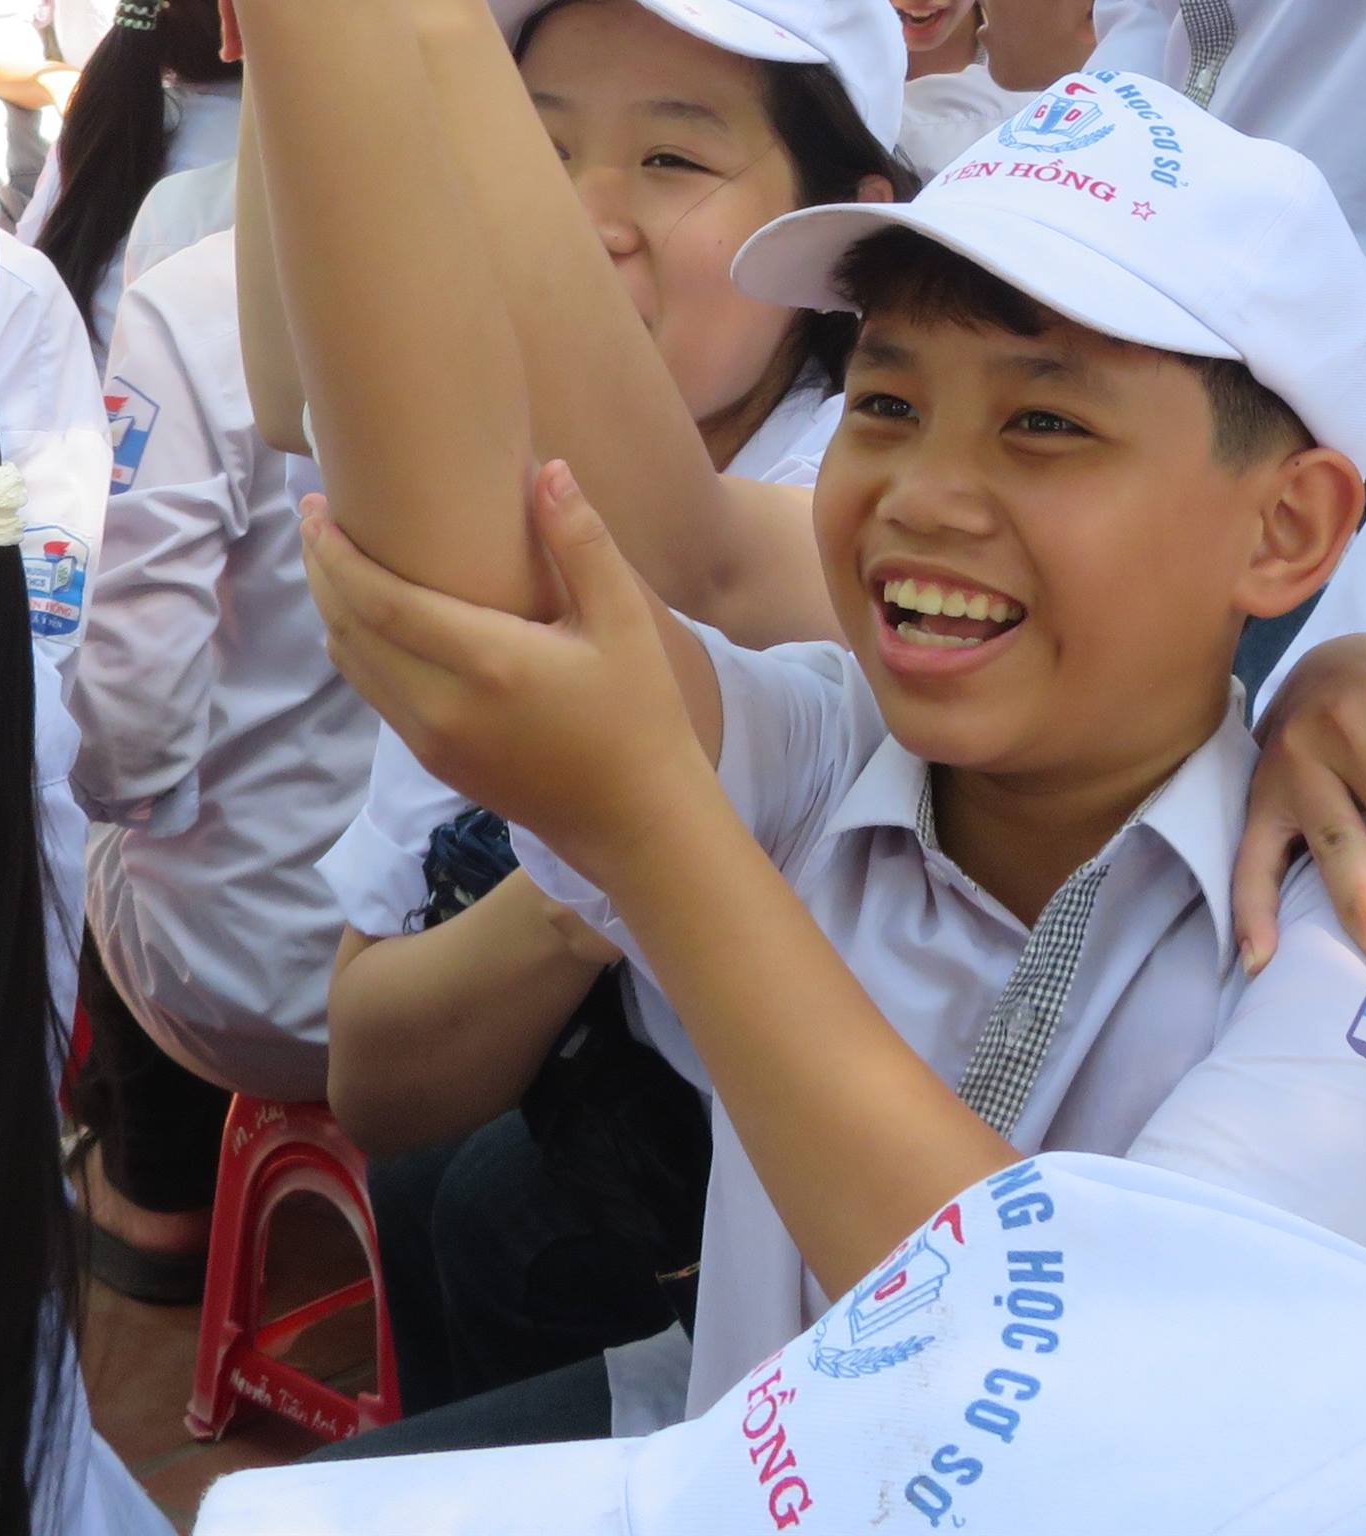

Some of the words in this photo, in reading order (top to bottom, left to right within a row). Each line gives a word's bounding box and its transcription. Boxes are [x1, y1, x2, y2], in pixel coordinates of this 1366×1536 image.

[1114, 83, 1164, 121] HỌC
[1148, 124, 1184, 154] CƠ
[1005, 158, 1119, 203] HỒNG
[1149, 156, 1190, 189] SỞ
[994, 1249, 1065, 1355] HỌC
[964, 1367, 1042, 1445] CƠ
[904, 1443, 984, 1530] SỞ
